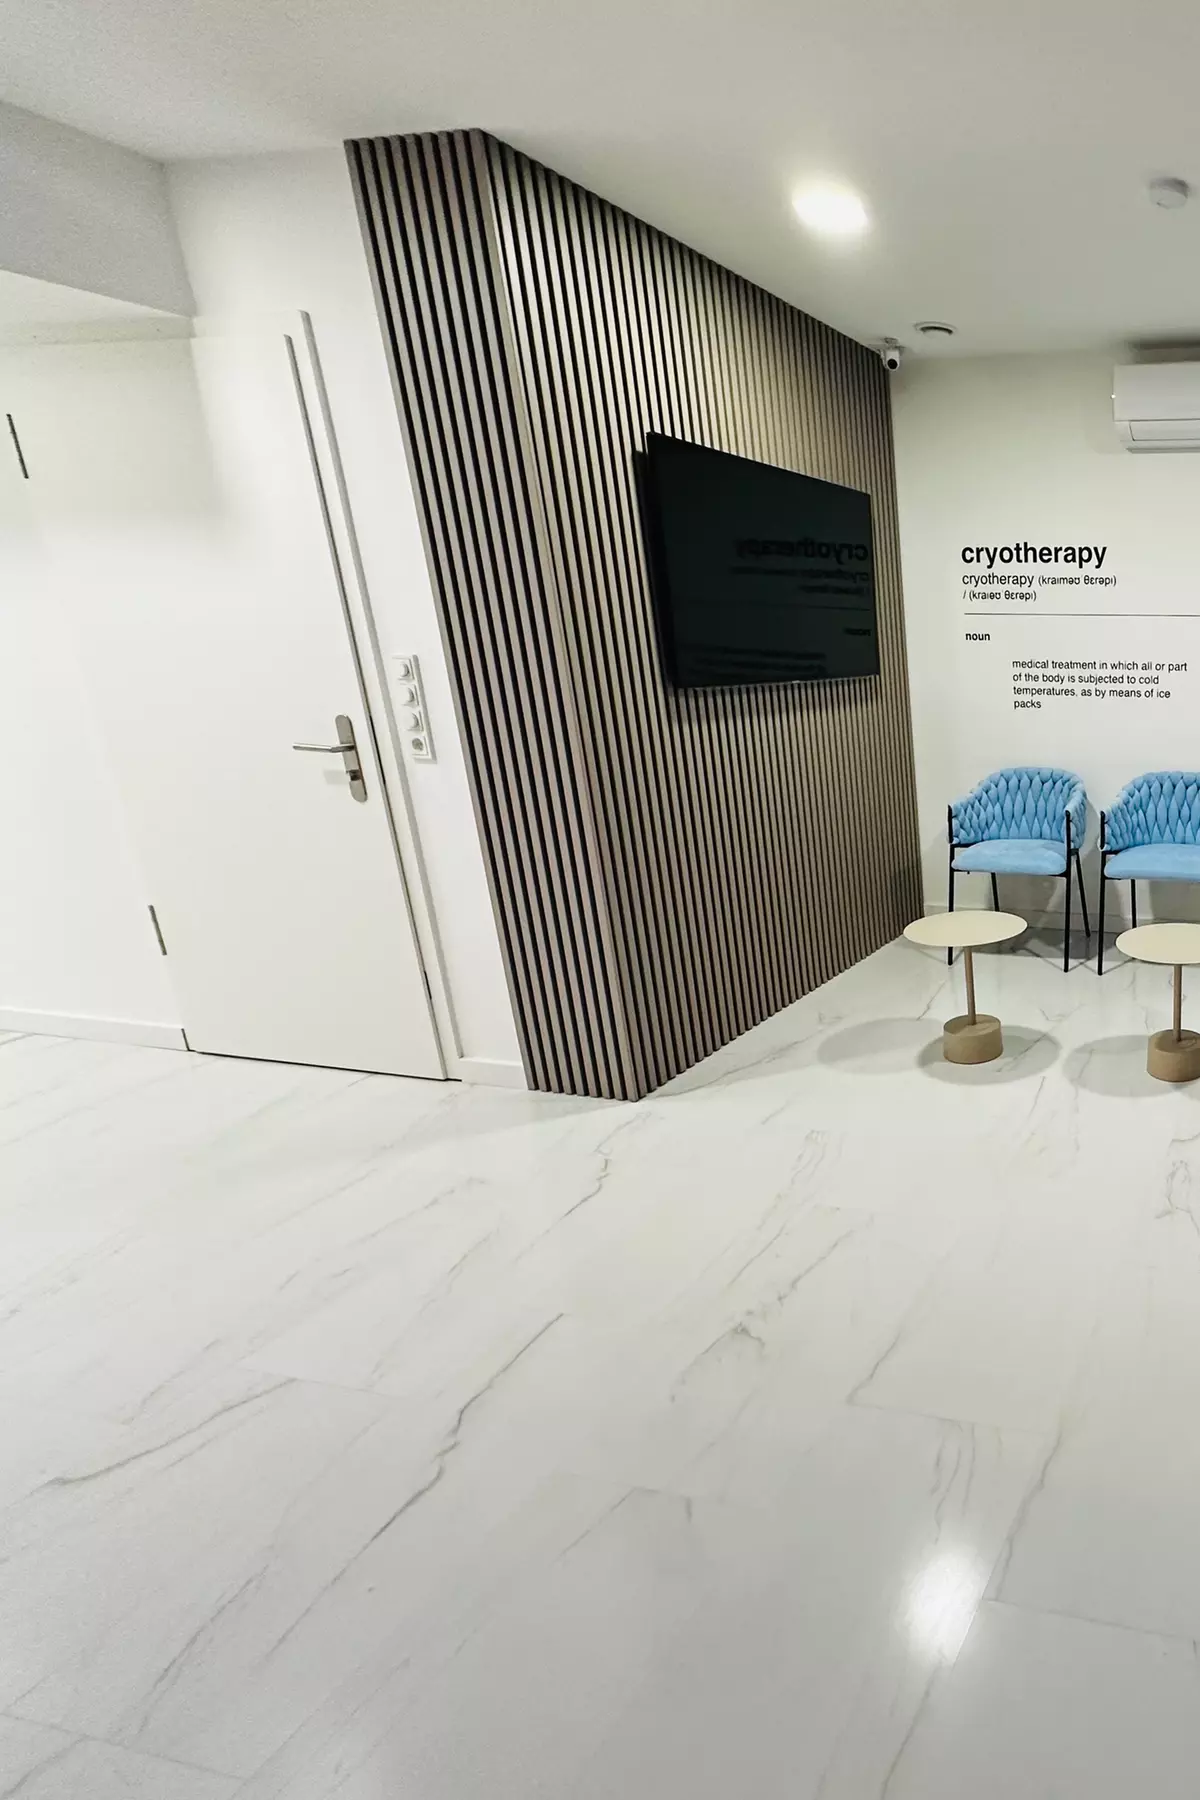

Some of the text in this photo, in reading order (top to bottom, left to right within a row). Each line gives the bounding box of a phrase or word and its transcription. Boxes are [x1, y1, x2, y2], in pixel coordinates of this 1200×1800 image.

[961, 541, 1107, 569] cryotherapy
[962, 572, 1034, 588] cryotherapy
[965, 633, 990, 641] noun
[1012, 659, 1187, 673] medical treatment in which all or part
[1013, 672, 1159, 685] of the body is subjected to cold
[1095, 687, 1106, 699] by
[1109, 690, 1142, 698] means
[1144, 688, 1154, 698] of
[1157, 689, 1171, 698] ice
[1014, 699, 1041, 710] packs
